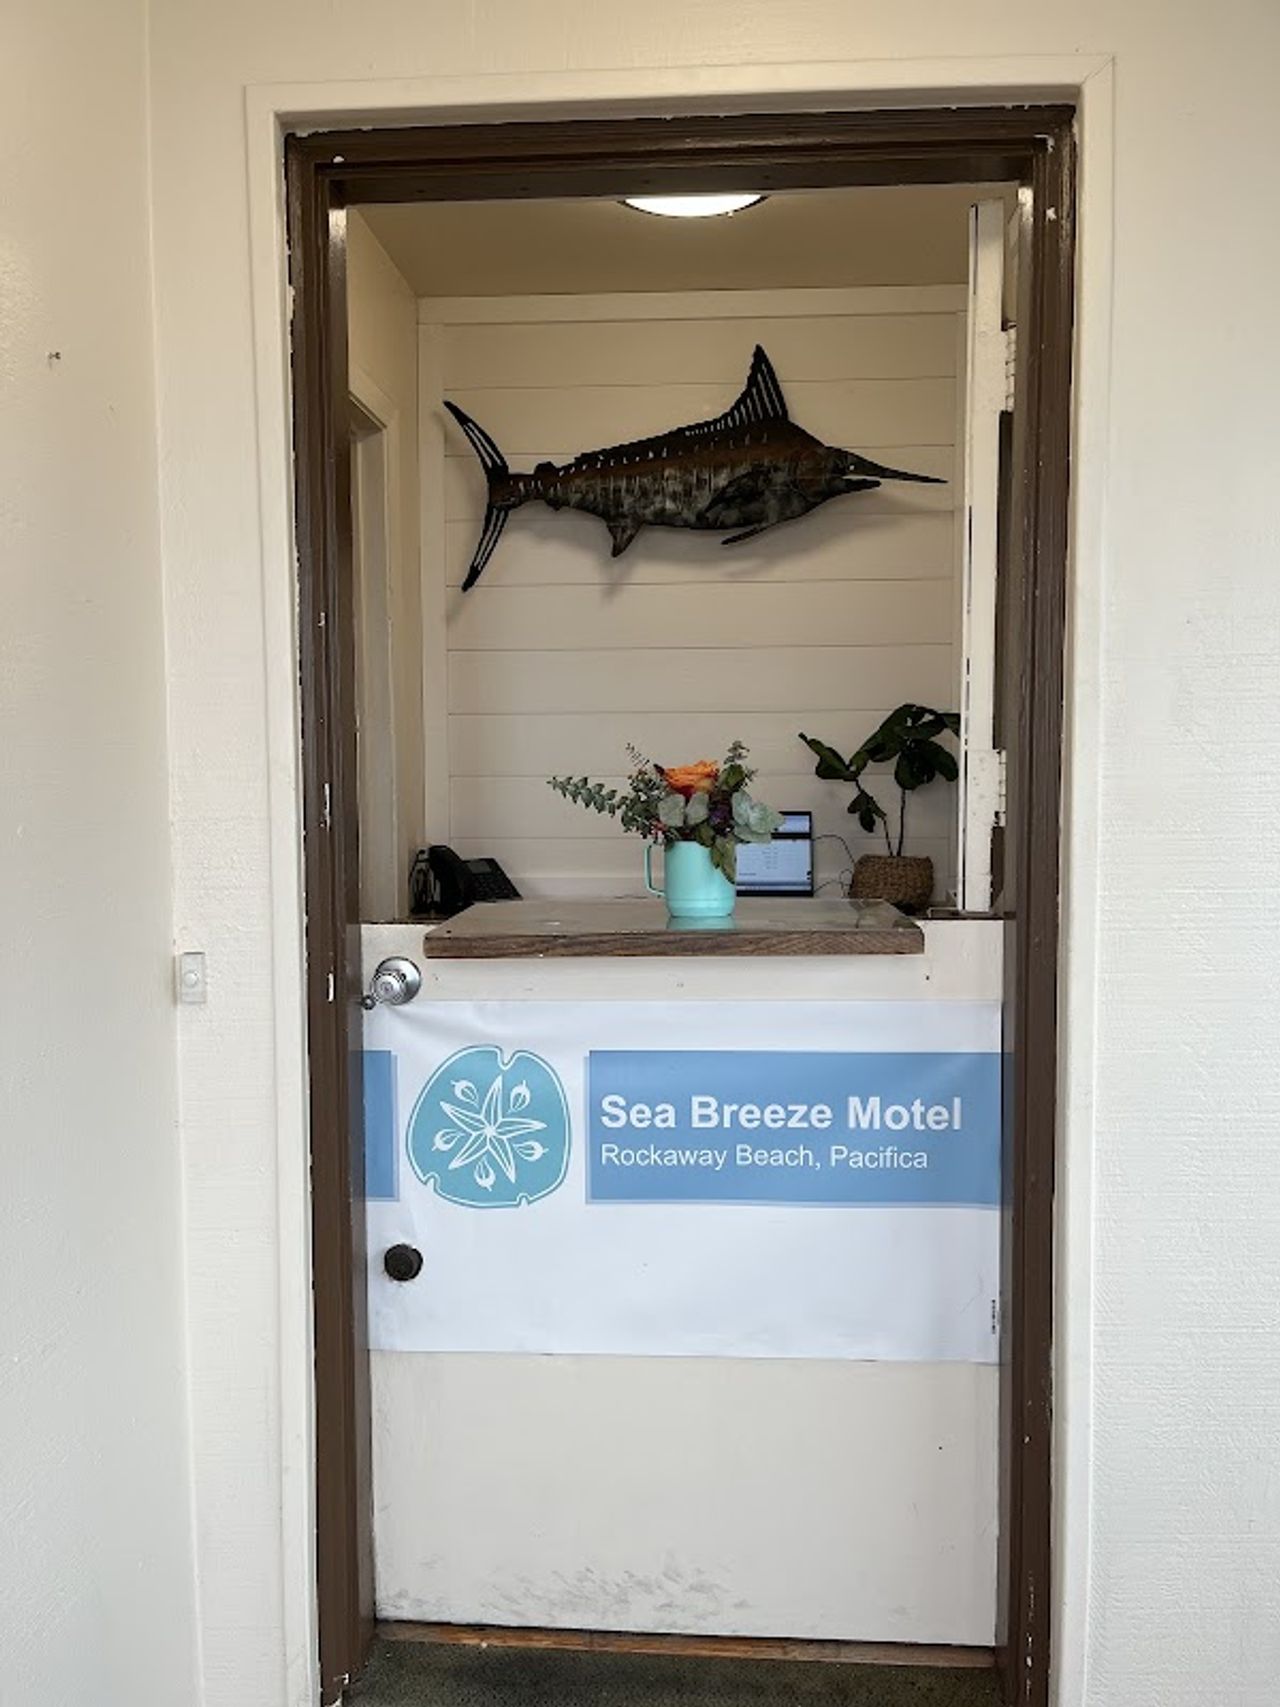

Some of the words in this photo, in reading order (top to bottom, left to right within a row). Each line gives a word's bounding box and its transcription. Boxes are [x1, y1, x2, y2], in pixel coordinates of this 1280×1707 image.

[600, 1094, 677, 1130] Sea
[691, 1095, 833, 1130] Breeze
[847, 1096, 963, 1131] Motel
[601, 1144, 727, 1172] Rockaway
[736, 1144, 821, 1170] Beach,
[830, 1145, 928, 1169] Pacifica
